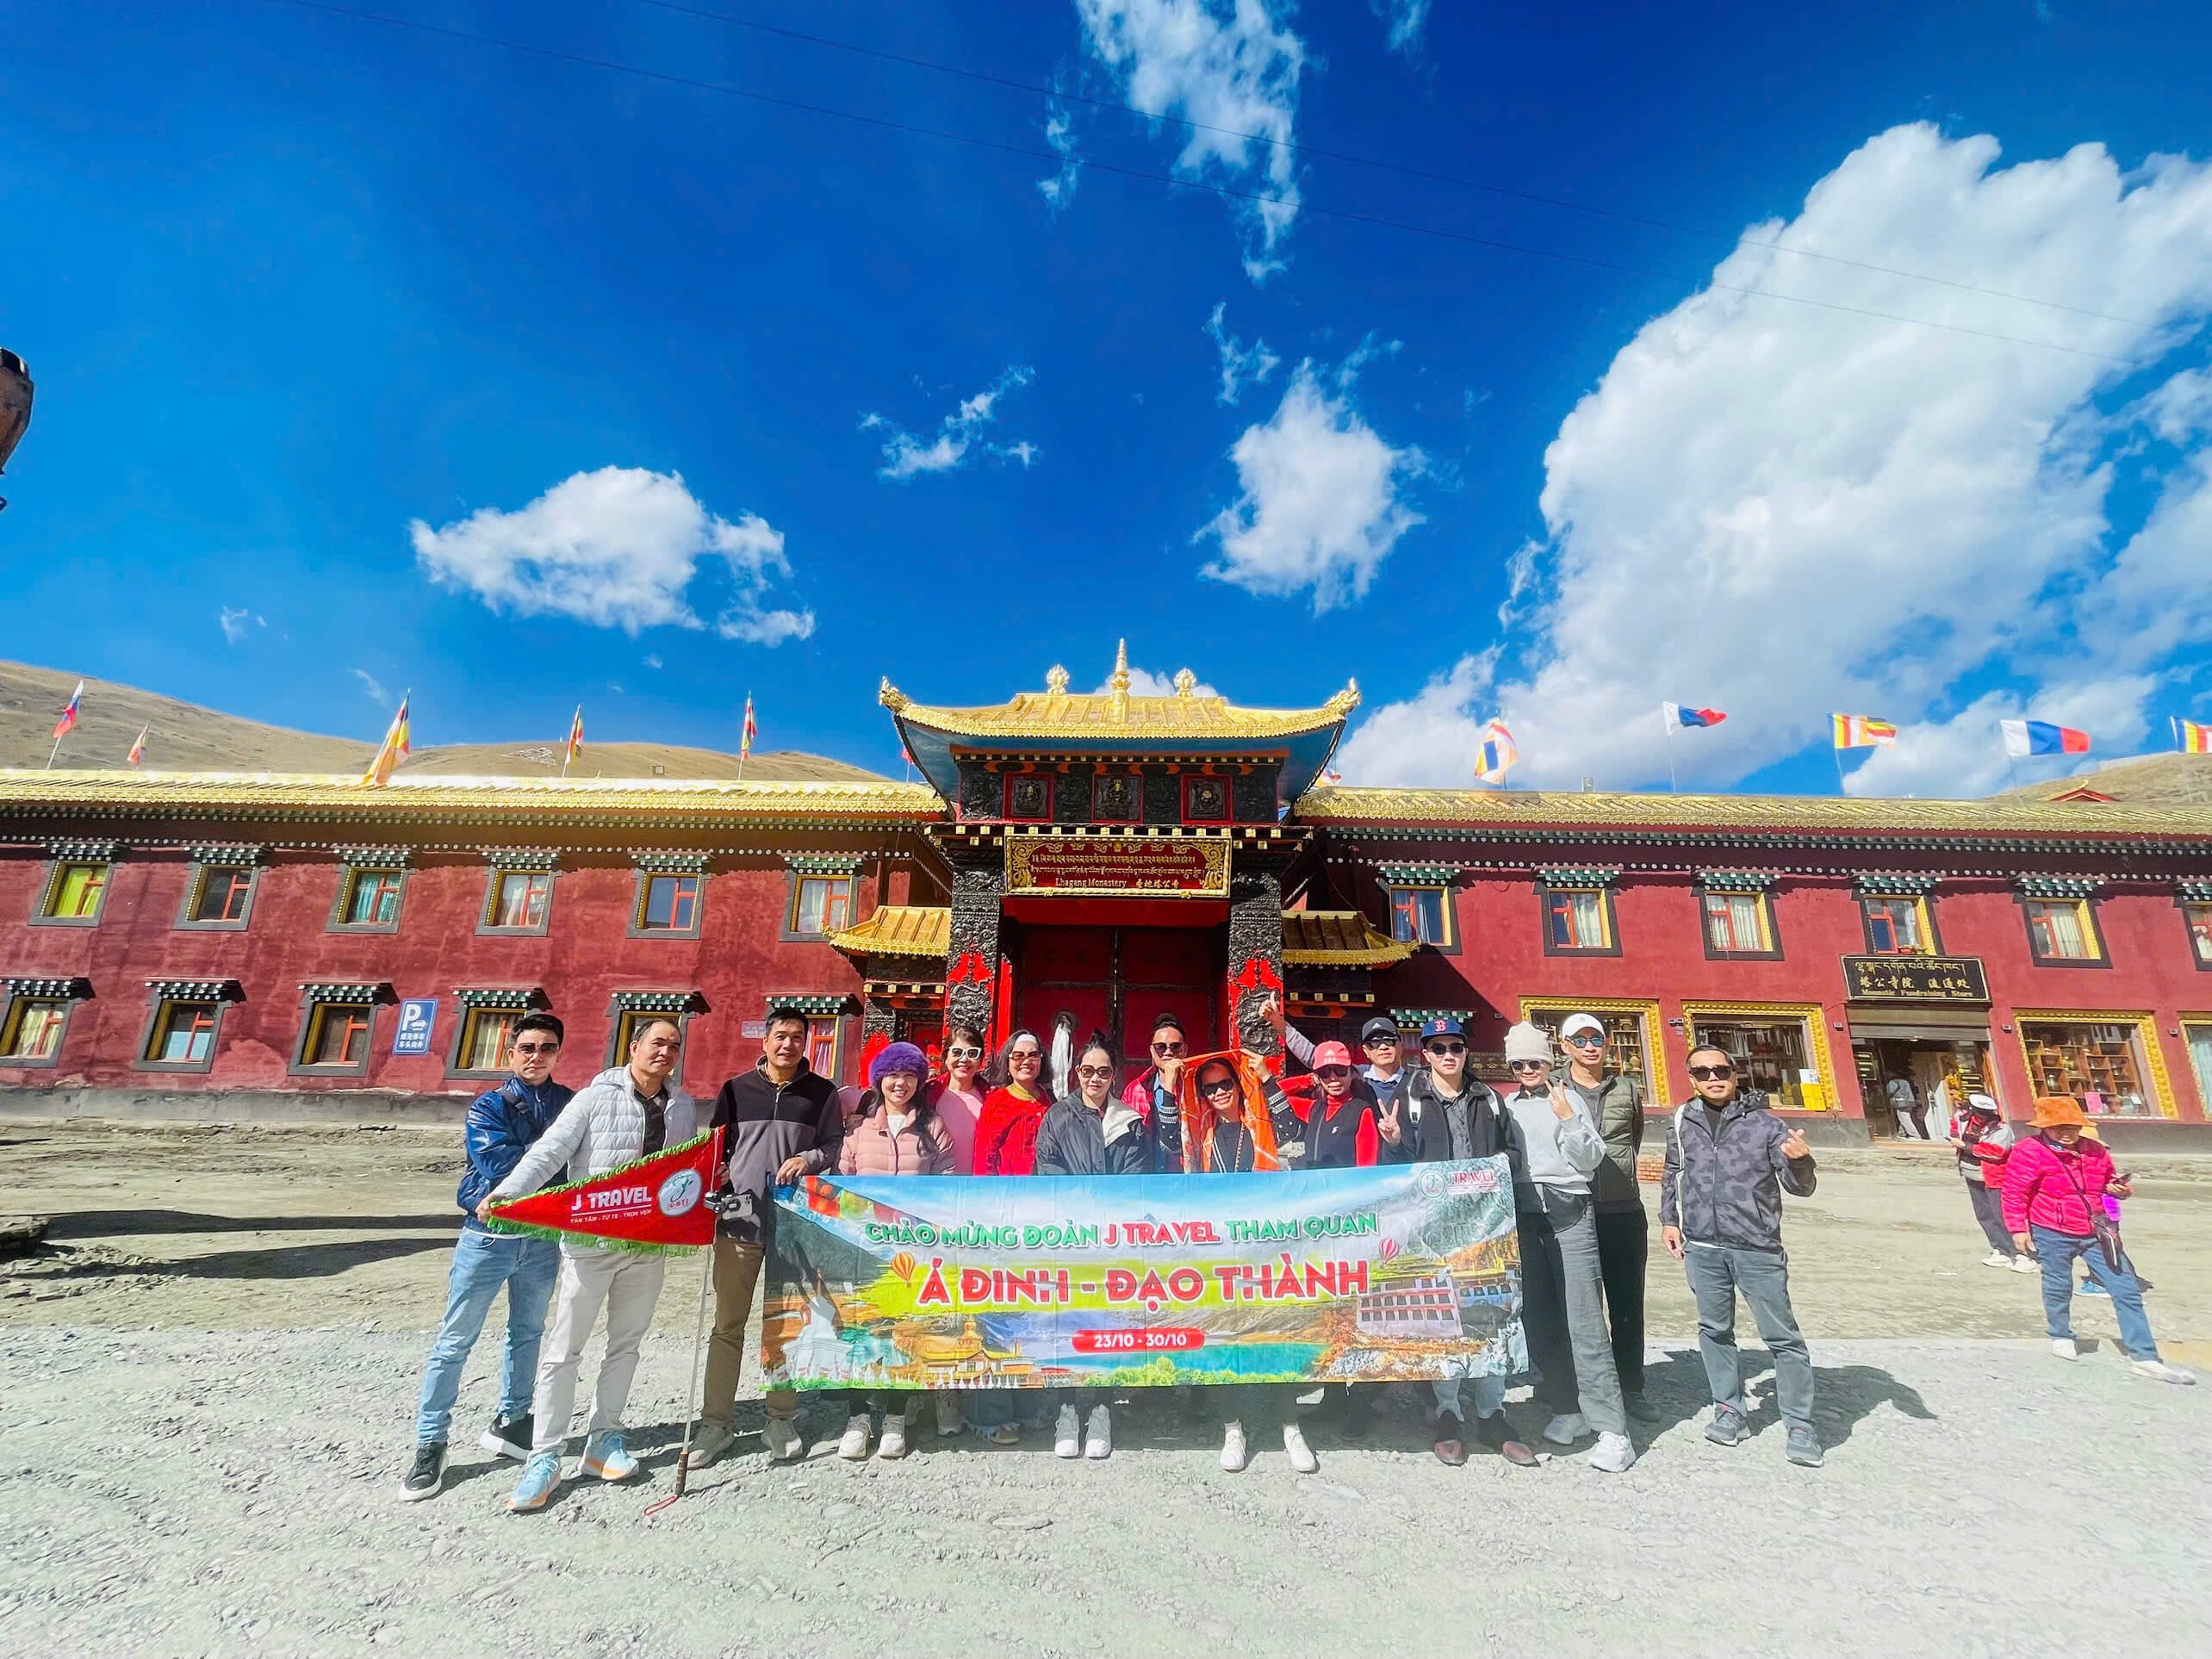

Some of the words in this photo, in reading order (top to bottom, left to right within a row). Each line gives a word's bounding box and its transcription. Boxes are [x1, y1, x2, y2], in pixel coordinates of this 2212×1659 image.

[1055, 878, 1087, 889] Lhagang
[1088, 879, 1127, 888] Monastery
[1900, 989, 1947, 997] Fundraising
[401, 1003, 421, 1031] P
[1433, 1019, 1447, 1032] B
[571, 1194, 581, 1211] J
[587, 1186, 652, 1209] TRAVEL
[668, 1198, 690, 1210] TRAVEL
[865, 1219, 936, 1246] CHÀO
[941, 1219, 1017, 1246] MỪNG
[1022, 1219, 1099, 1246] ĐOÀN
[1103, 1223, 1117, 1246] J
[1122, 1221, 1221, 1245] TRAVEL
[1226, 1219, 1299, 1241] THAM
[1303, 1213, 1376, 1240] QUAN
[919, 1258, 951, 1303] Á
[960, 1268, 1068, 1302] ĐINH
[1106, 1267, 1204, 1312] ĐẠO
[1215, 1252, 1368, 1301] THÀNH
[1094, 1334, 1134, 1348] 23/10
[1146, 1333, 1187, 1347] 30/10
